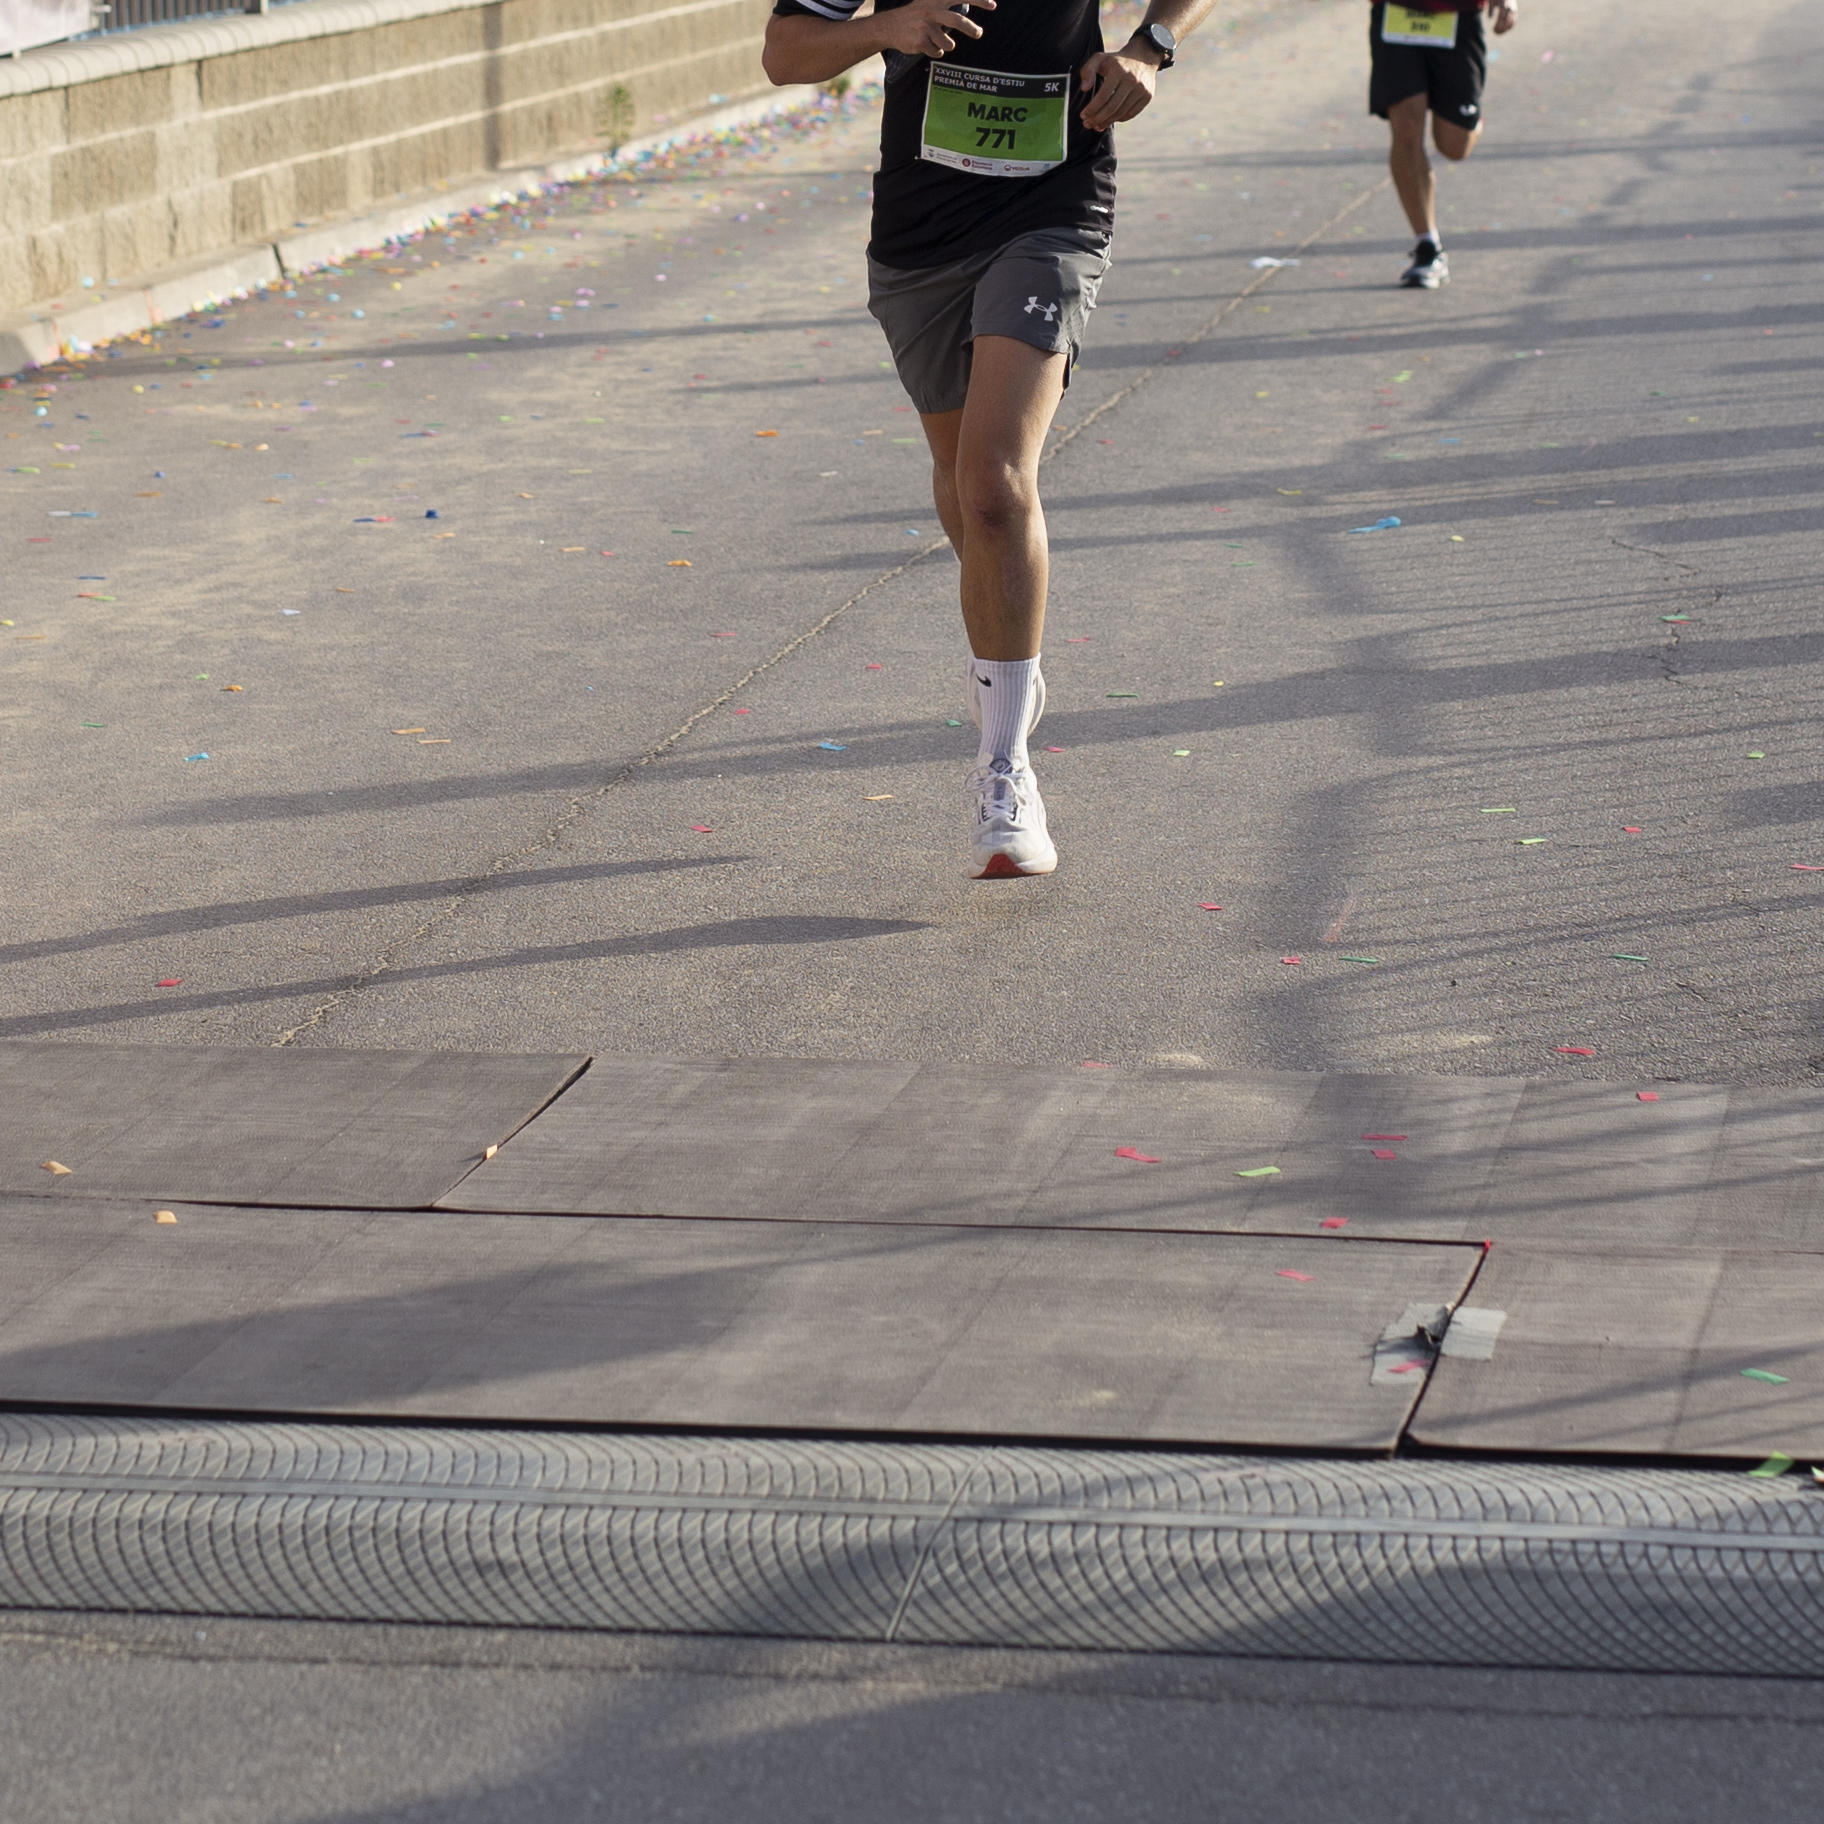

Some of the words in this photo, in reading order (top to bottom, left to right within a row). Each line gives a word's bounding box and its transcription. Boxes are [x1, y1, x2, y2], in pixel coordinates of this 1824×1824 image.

[964, 73, 990, 83] CURSA
[992, 76, 1026, 87] D'ESTIU
[966, 81, 977, 90] DE
[979, 83, 998, 93] MAR
[1044, 82, 1059, 92] 5K
[967, 101, 1028, 123] MARC
[976, 126, 1016, 150] 771
